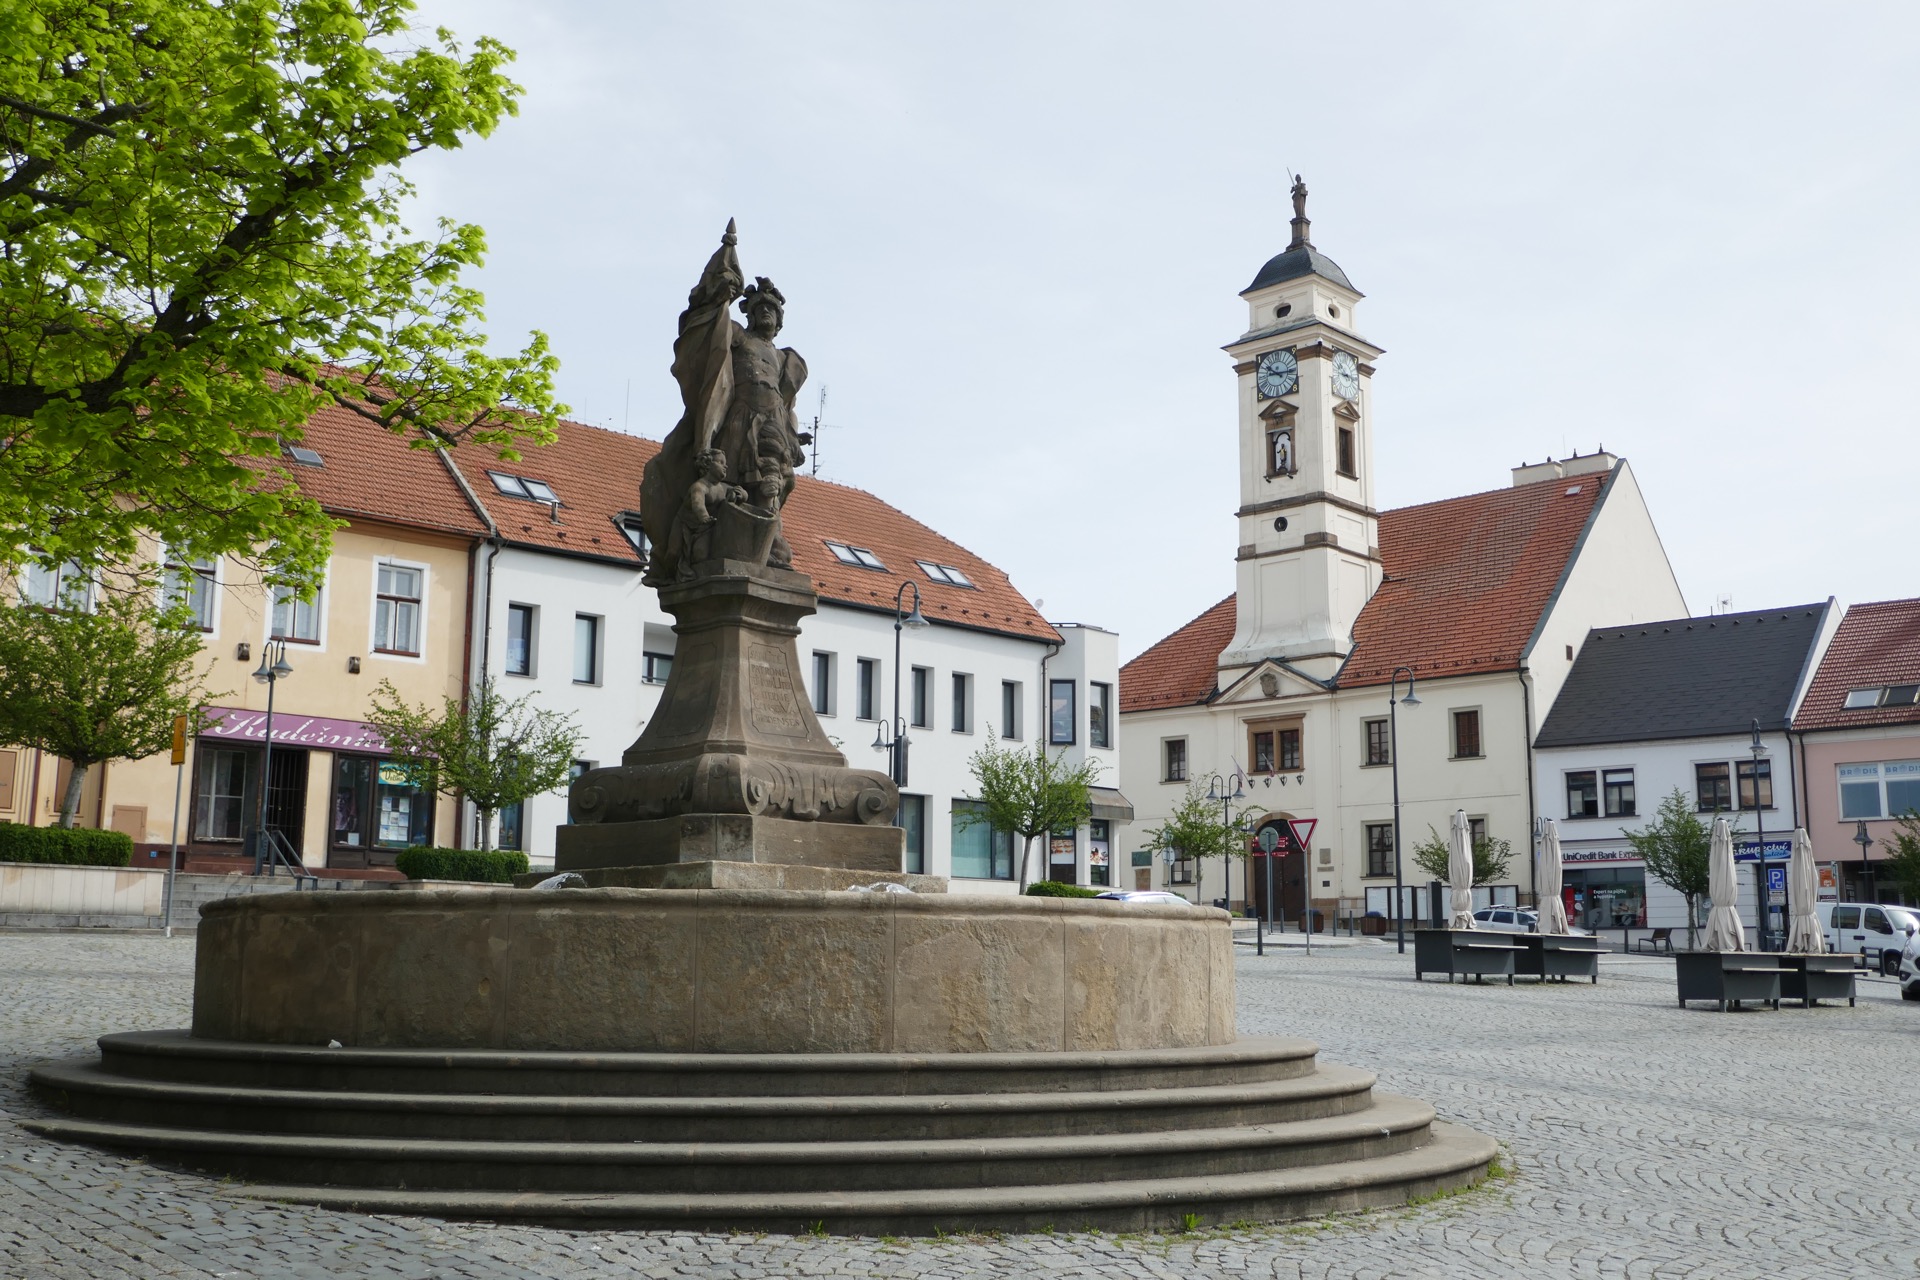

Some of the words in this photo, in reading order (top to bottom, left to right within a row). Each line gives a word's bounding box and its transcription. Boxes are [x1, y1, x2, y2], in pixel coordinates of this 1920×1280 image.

[1563, 851, 1597, 861] UniCredit
[1598, 851, 1617, 860] Bank
[1771, 871, 1781, 884] P
